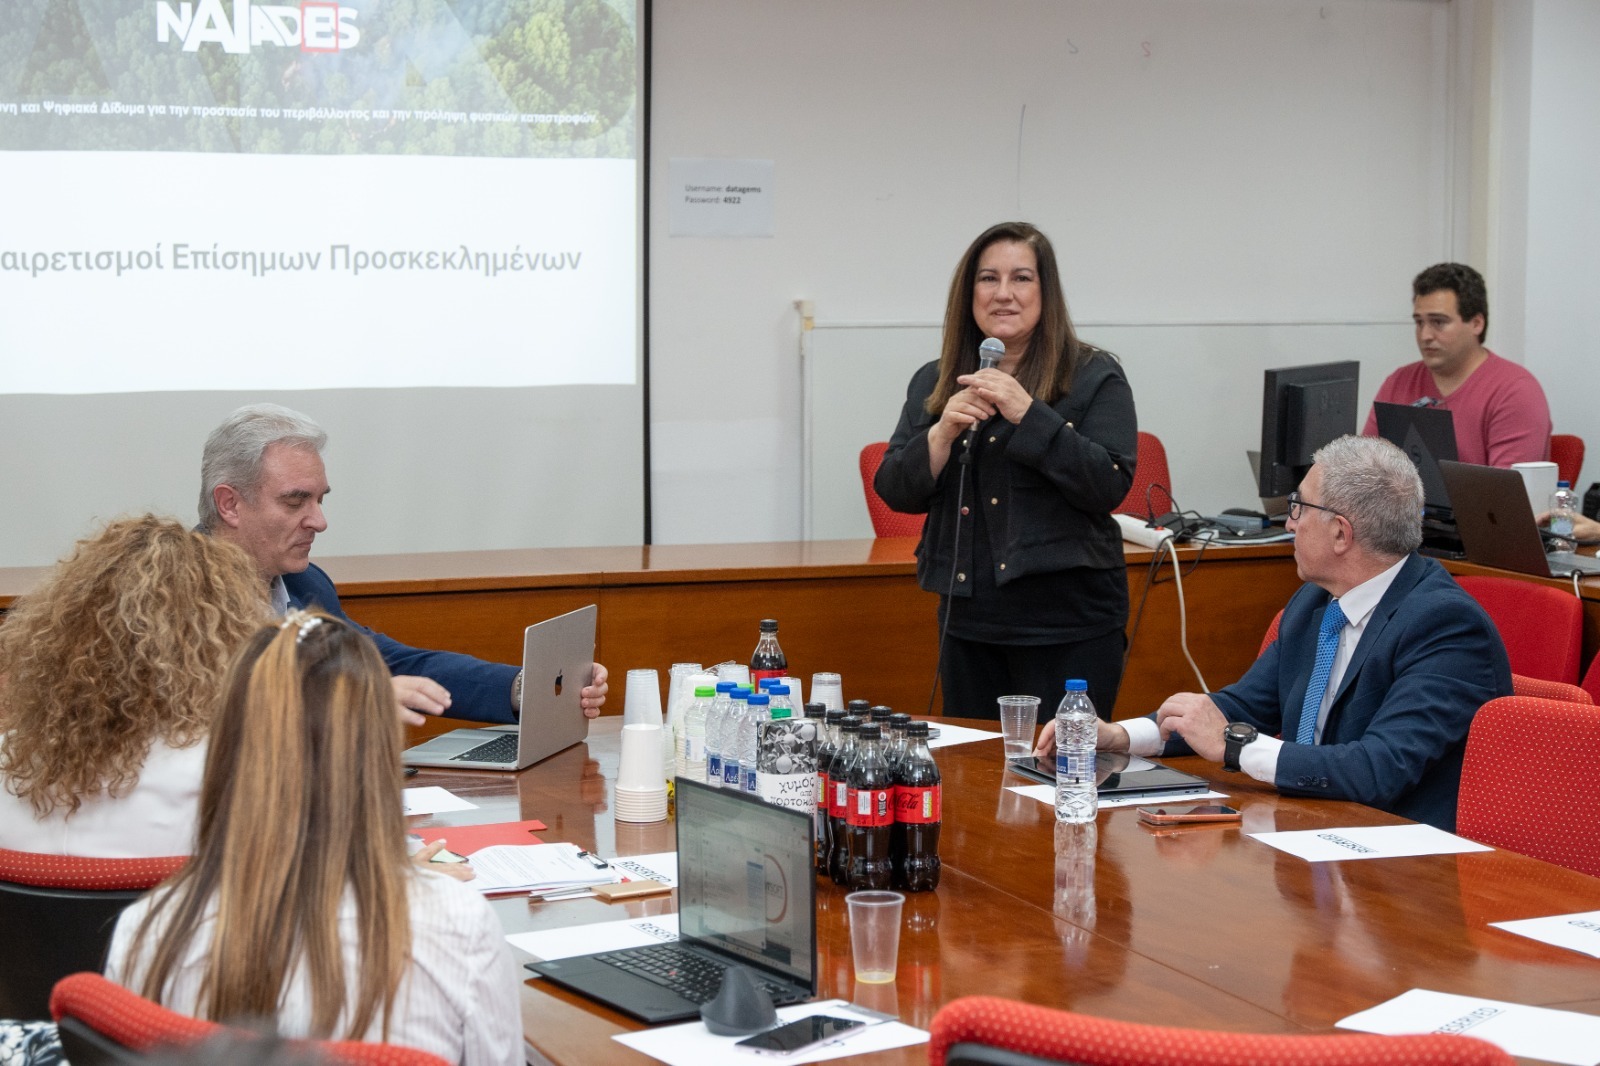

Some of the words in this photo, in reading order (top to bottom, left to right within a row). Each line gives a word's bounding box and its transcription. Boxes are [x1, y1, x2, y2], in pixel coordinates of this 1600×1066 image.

[157, 0, 360, 53] NAIADES
[21, 103, 40, 114] και
[43, 101, 98, 116] Ψηφιακά
[100, 102, 145, 116] Δίδυμα
[148, 104, 166, 117] για
[169, 104, 189, 117] την
[193, 105, 257, 118] προστασία
[261, 107, 280, 118] του
[283, 107, 369, 120] περιβάλλοντος
[372, 109, 389, 120] και
[393, 109, 411, 120] την
[414, 110, 467, 123] πρόληψη
[470, 111, 517, 123] φυσικών
[685, 184, 721, 192] Username:
[725, 185, 761, 193] datagems
[685, 196, 720, 204] Password:
[172, 243, 321, 277] Επίσημων
[330, 244, 582, 277] Προσκεκλημένων
